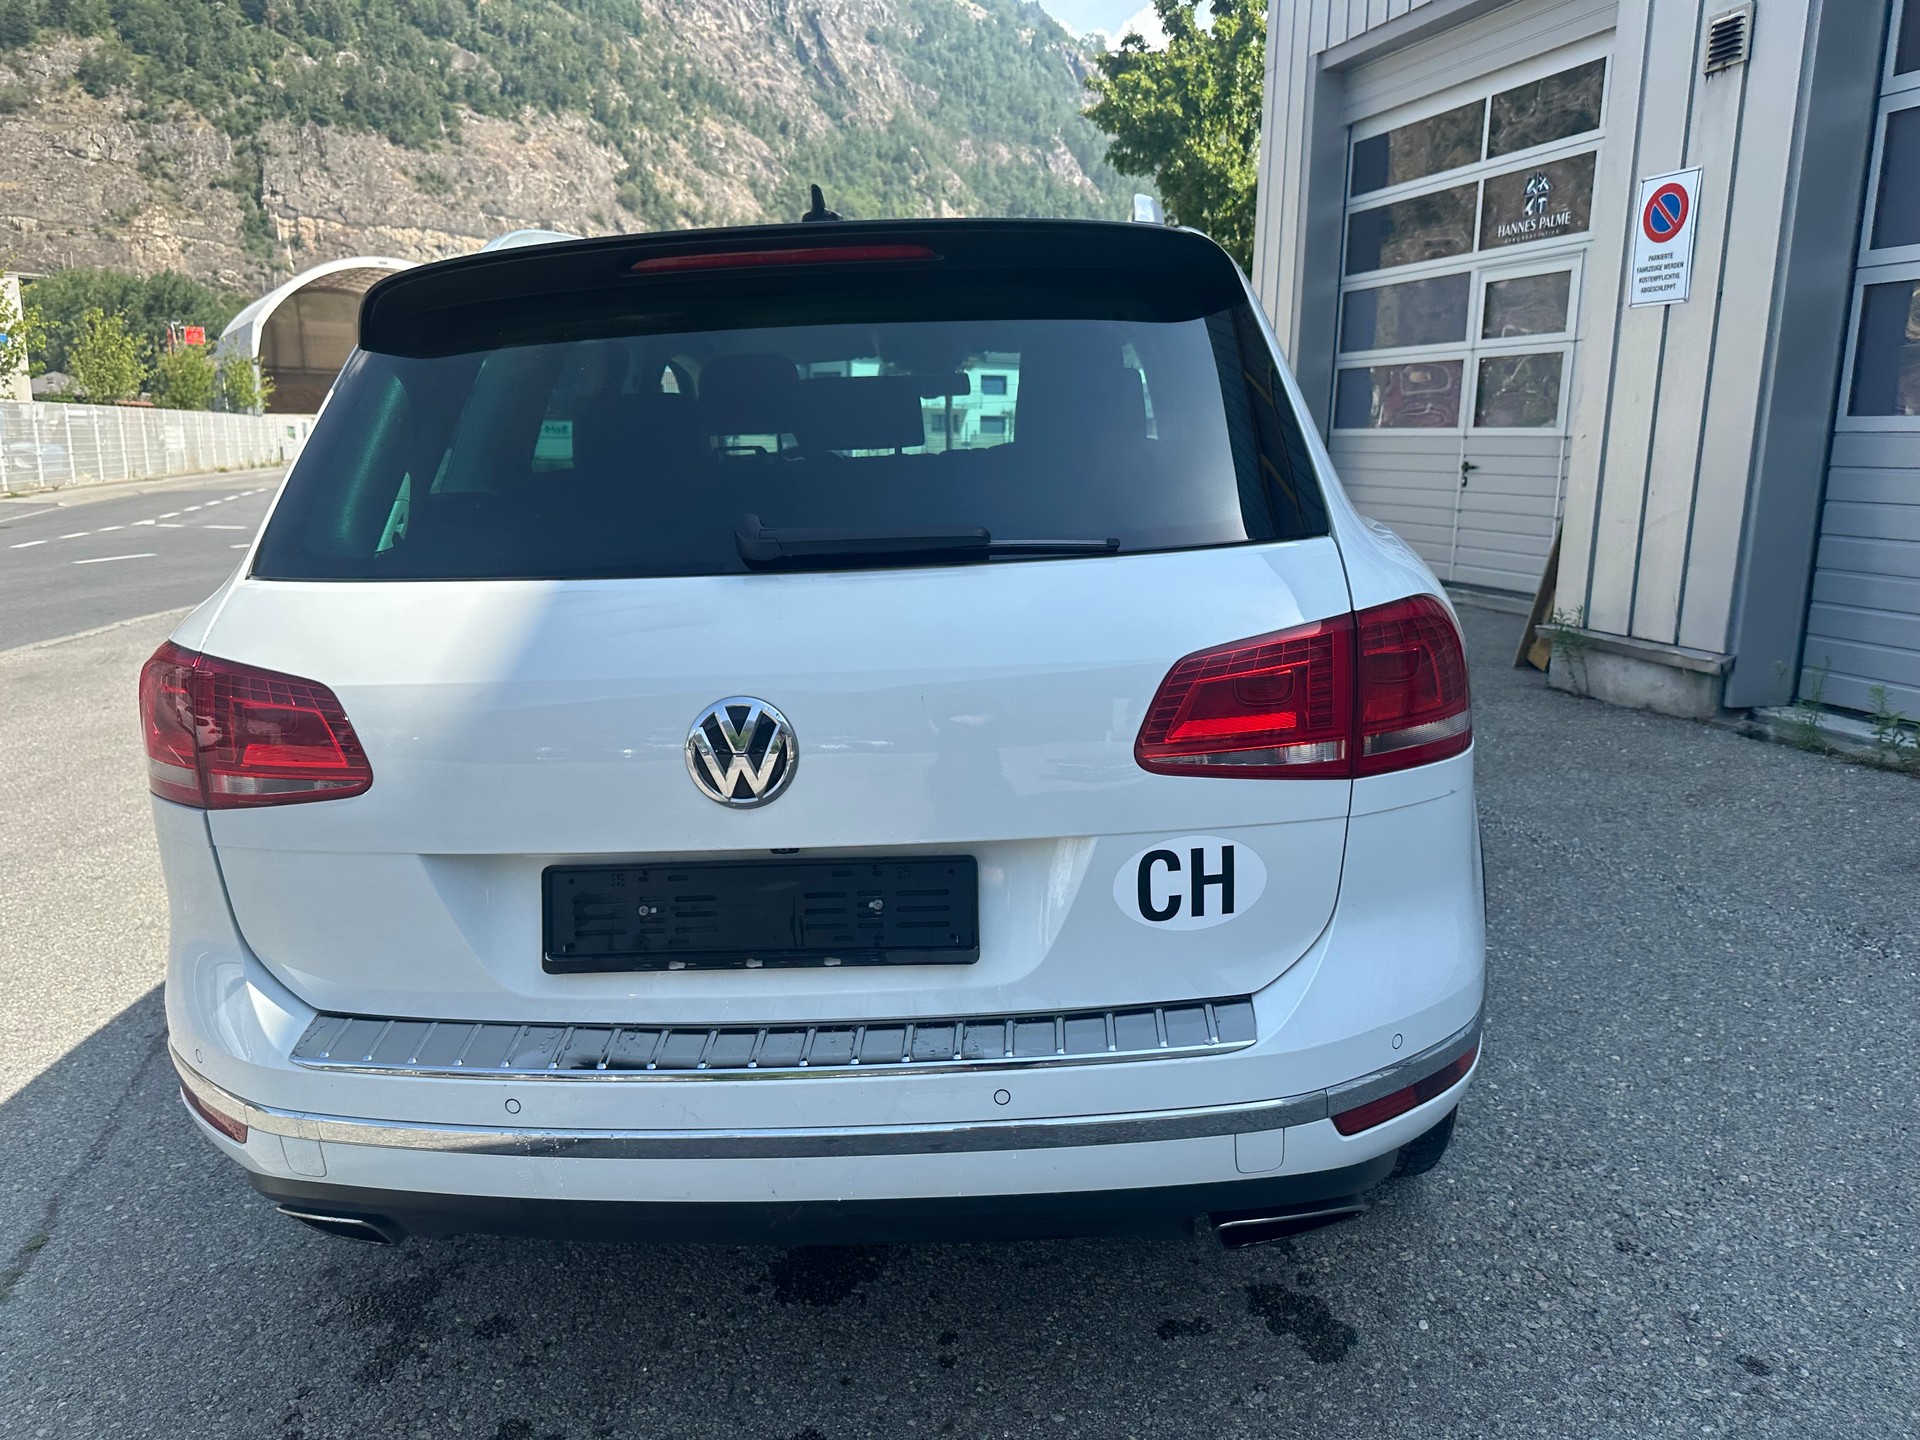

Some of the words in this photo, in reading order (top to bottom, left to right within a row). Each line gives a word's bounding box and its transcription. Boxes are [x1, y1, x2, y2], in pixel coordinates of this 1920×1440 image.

[1497, 219, 1536, 237] HANNES
[1539, 211, 1571, 230] PALME
[1648, 252, 1673, 262] PARKIERTE
[1636, 264, 1663, 273] FAHRZEUGE
[1663, 261, 1684, 270] WERDEN
[1638, 272, 1680, 283] KOSTENPFLICHTIG
[1640, 283, 1676, 293] ABGESCHLEPPT
[689, 699, 794, 804] VW
[1137, 845, 1235, 922] CH
